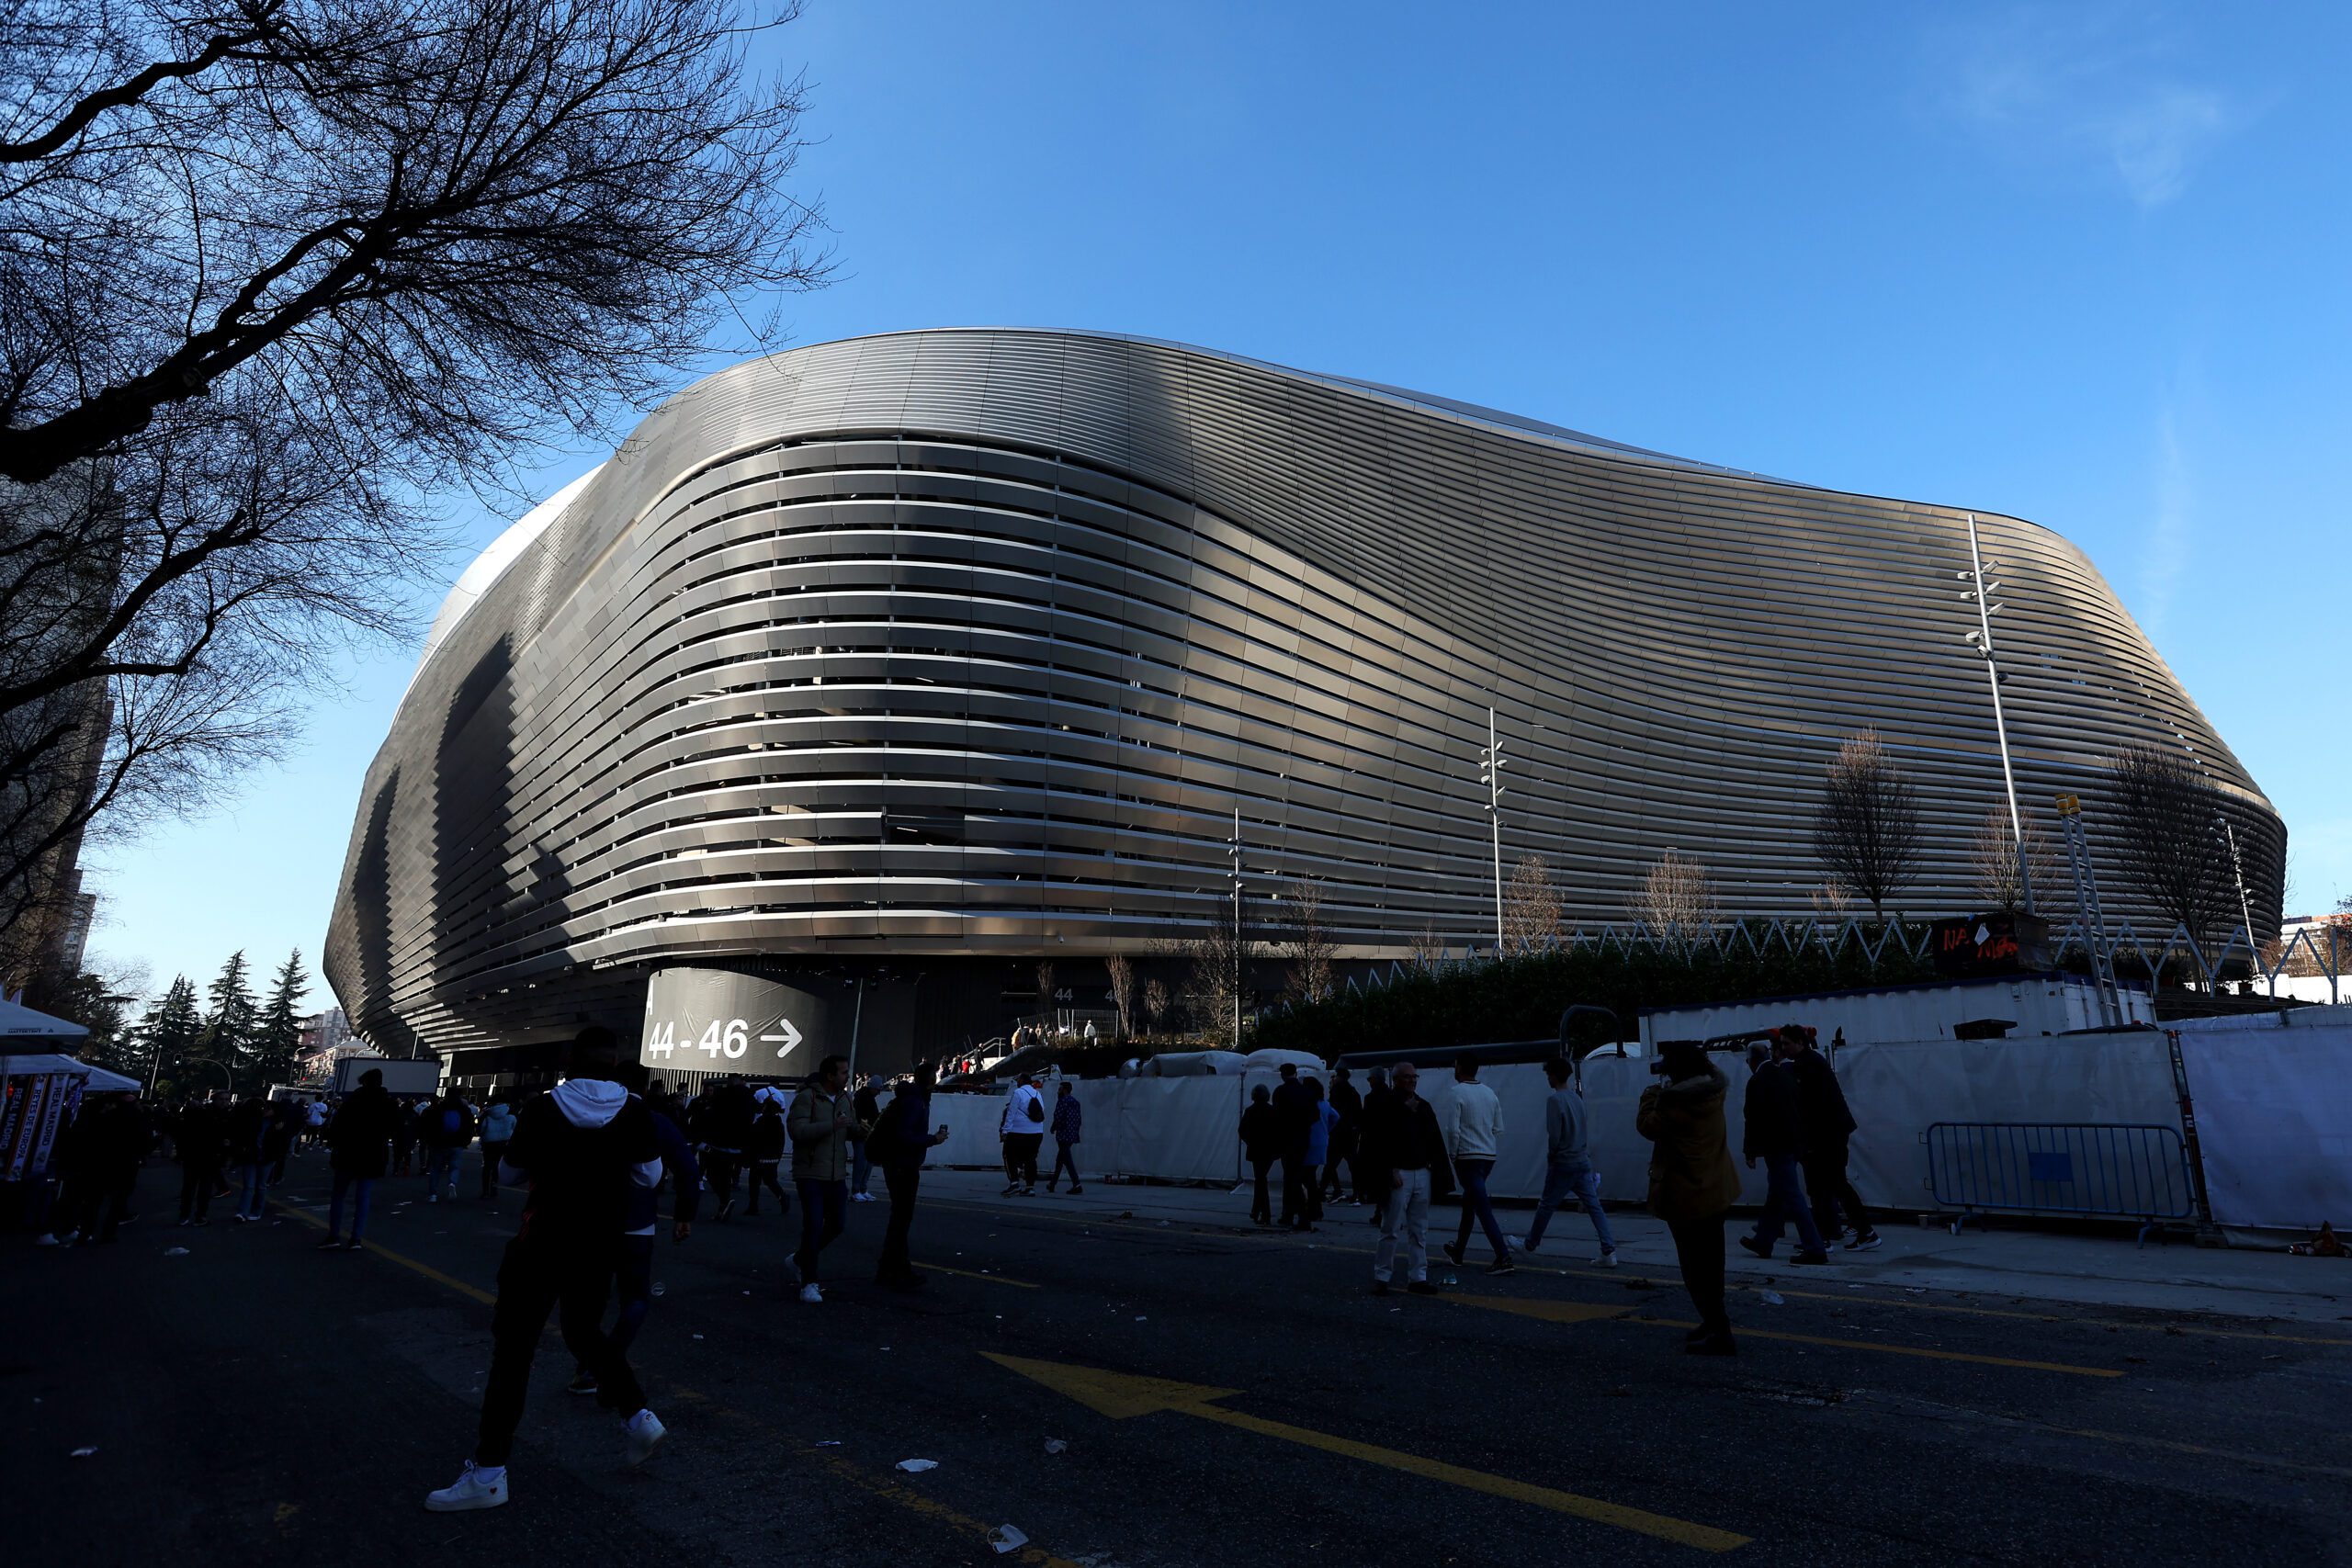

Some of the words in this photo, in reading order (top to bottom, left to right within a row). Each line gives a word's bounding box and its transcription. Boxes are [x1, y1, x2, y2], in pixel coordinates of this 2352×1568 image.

[1054, 987, 1073, 1001] 44
[649, 1021, 674, 1059] 44
[698, 1019, 749, 1058] 46
[26, 1115, 35, 1126] DE
[17, 1127, 31, 1159] EUROPA
